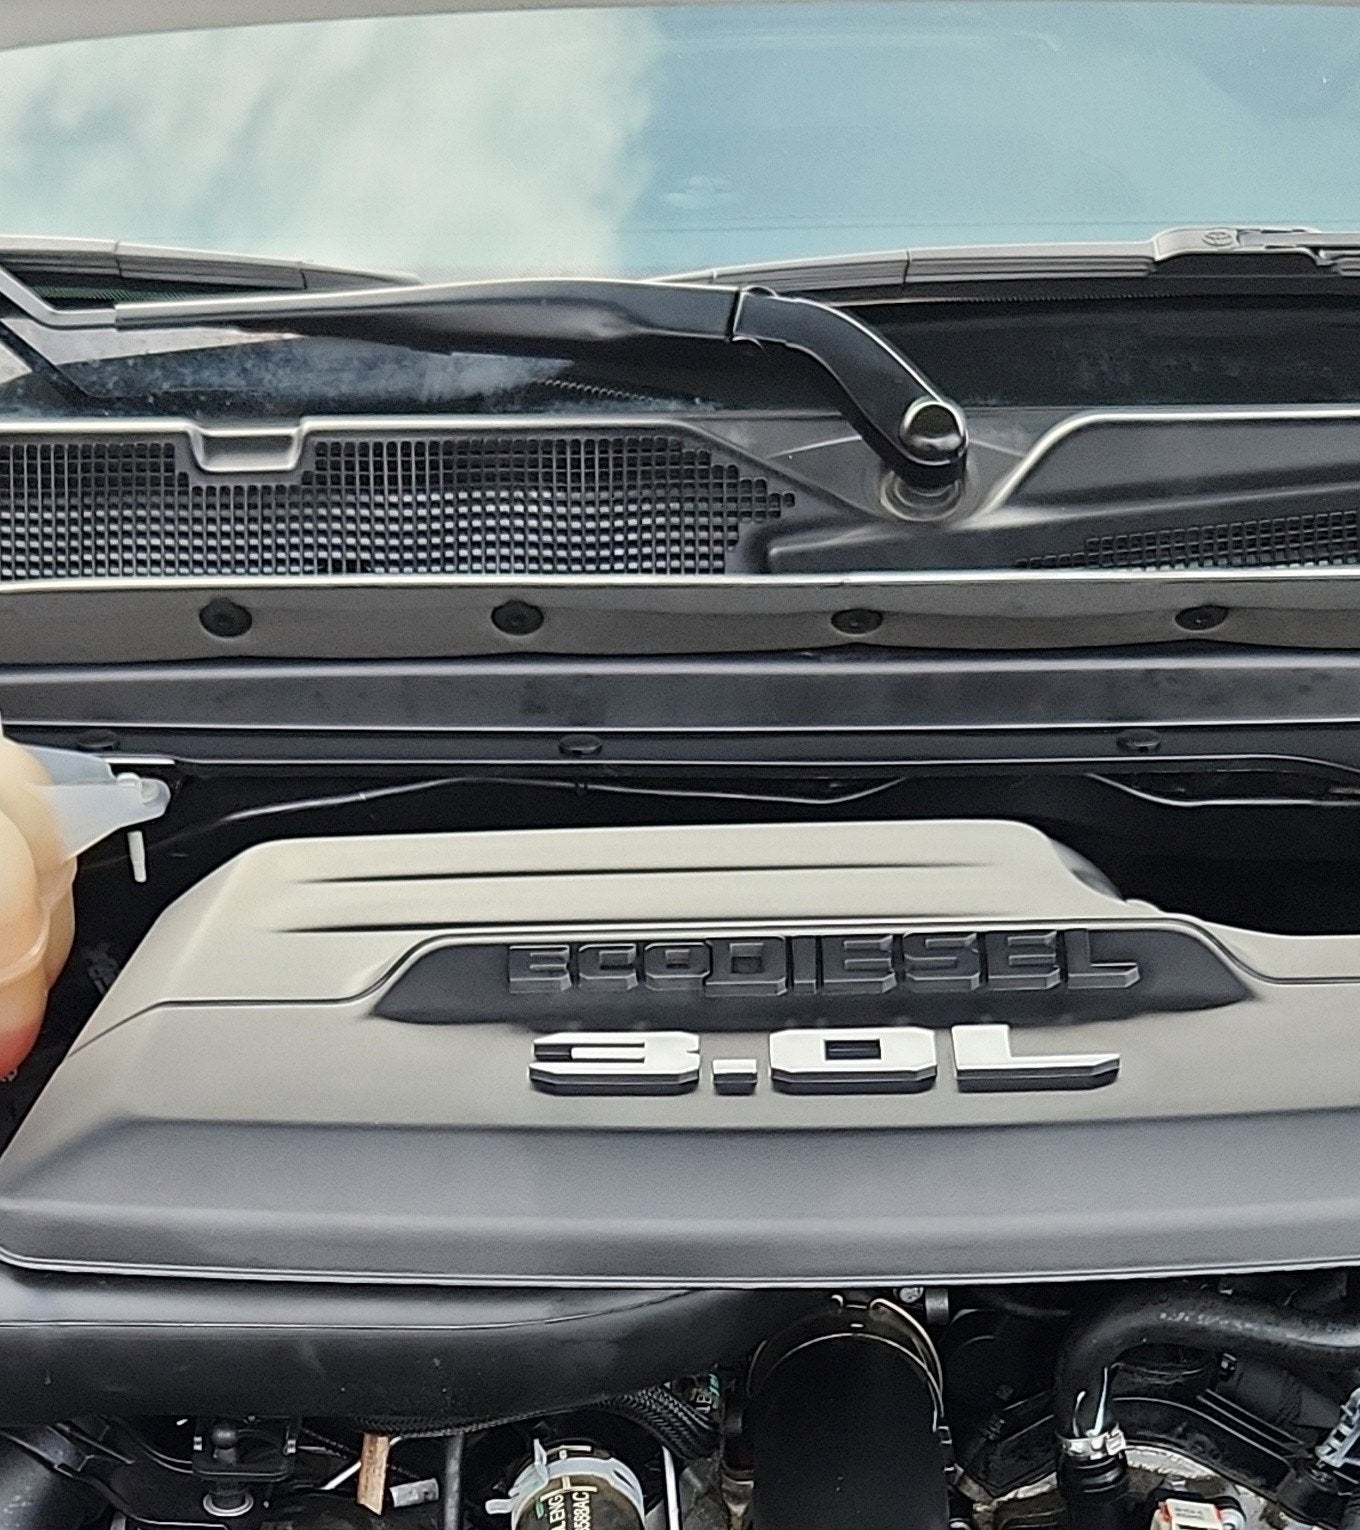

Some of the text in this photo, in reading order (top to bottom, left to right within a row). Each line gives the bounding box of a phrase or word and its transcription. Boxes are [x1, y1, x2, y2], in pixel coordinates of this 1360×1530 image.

[507, 926, 1142, 995] ECODIESEL
[528, 1023, 1121, 1096] 3.0L
[548, 1493, 566, 1524] ENG
